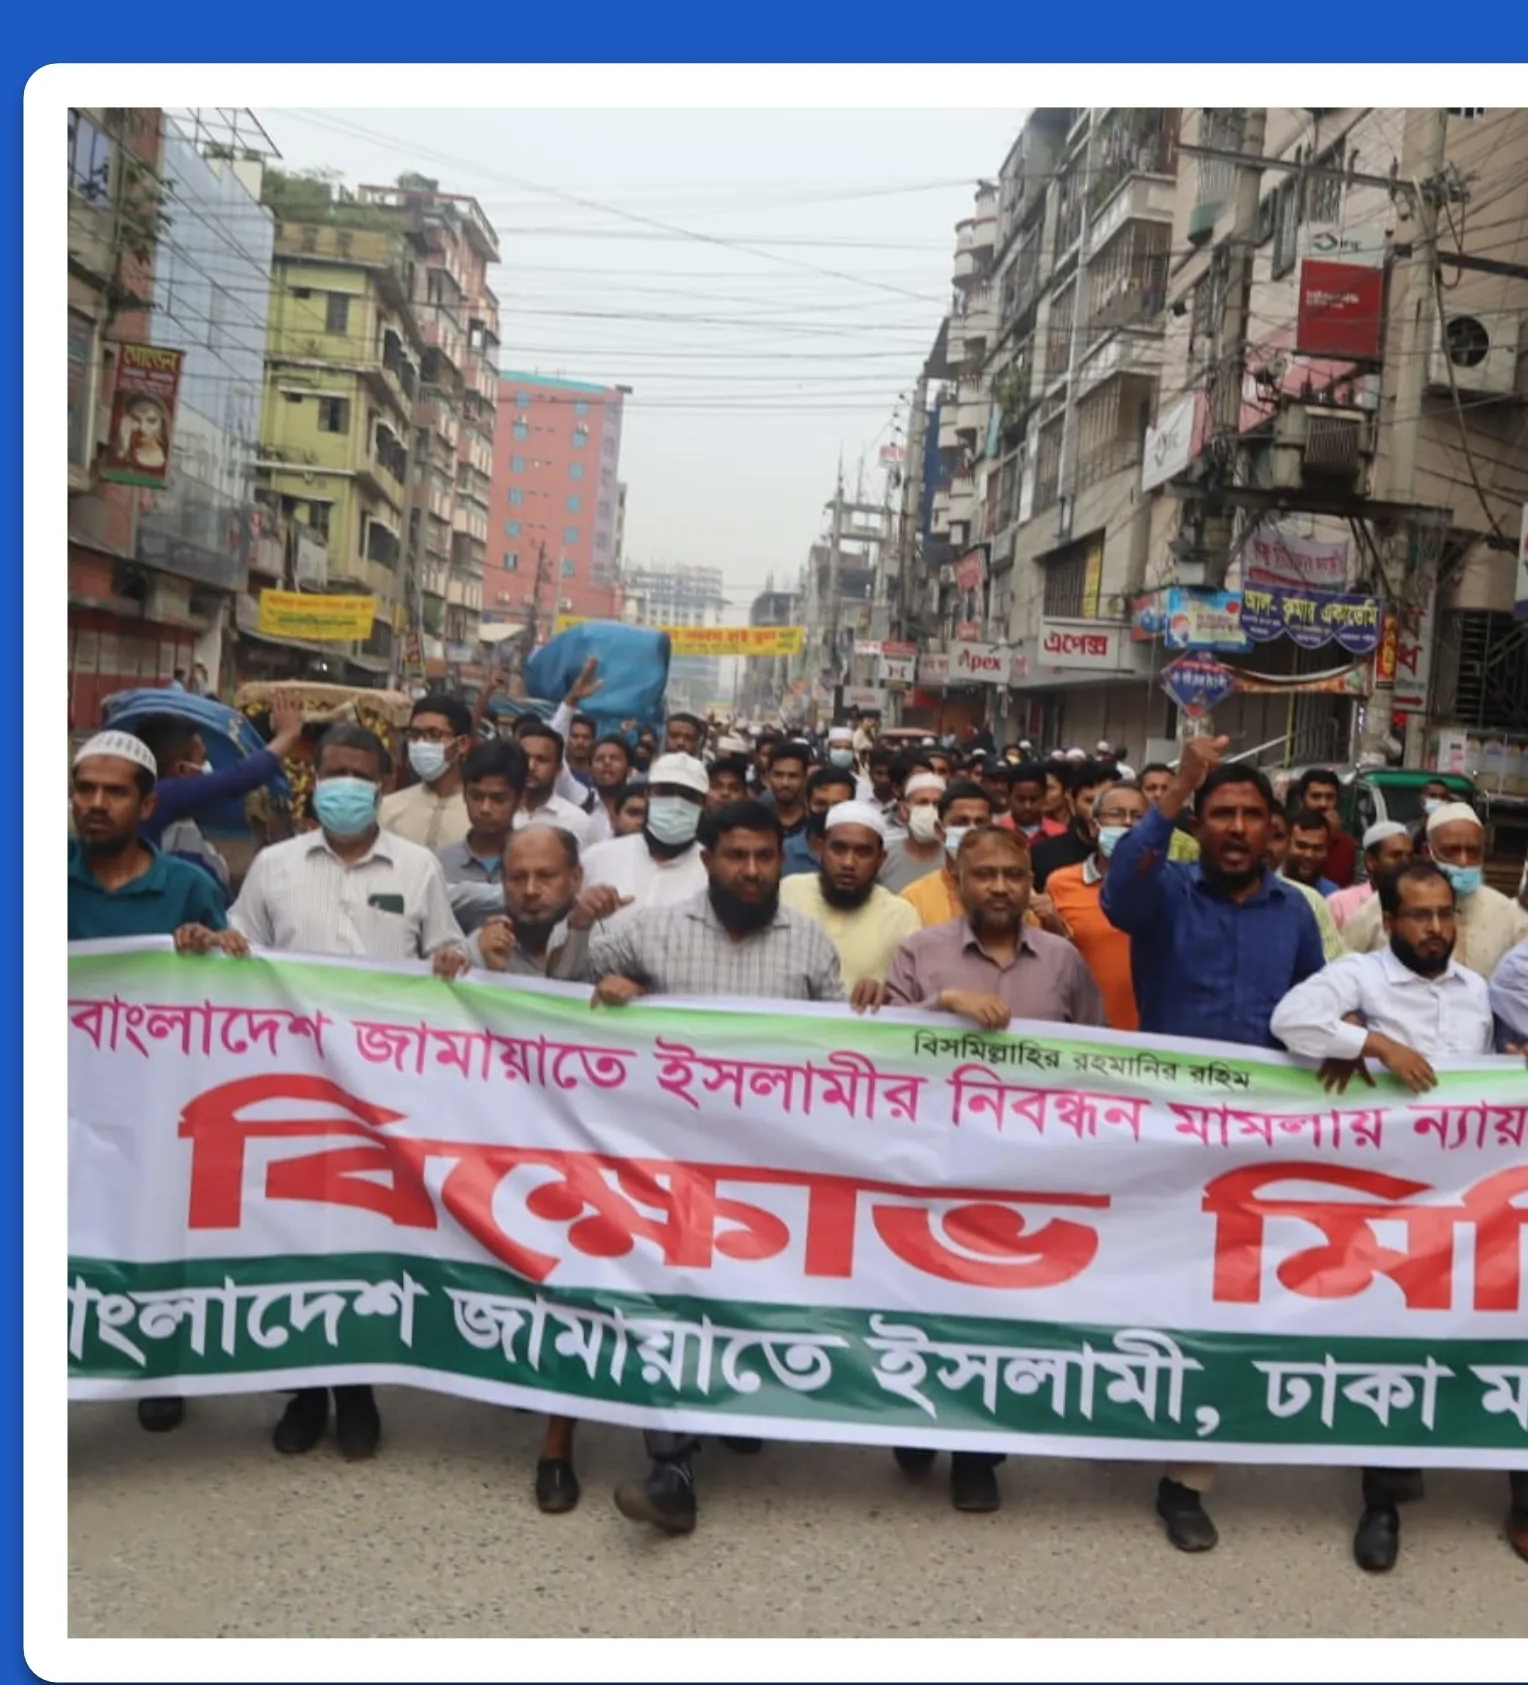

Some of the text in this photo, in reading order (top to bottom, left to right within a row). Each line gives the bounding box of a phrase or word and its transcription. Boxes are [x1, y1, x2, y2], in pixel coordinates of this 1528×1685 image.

[957, 648, 1003, 673] Apex
[1043, 631, 1109, 657] এপেক্স
[67, 993, 331, 1061] বাংলাদেশ
[354, 1018, 636, 1092] জামায়াতে
[654, 1035, 930, 1122] ইসলামীর
[945, 1062, 1157, 1143] নিবন্ধন
[1165, 1099, 1391, 1151] মামলায়
[913, 1029, 1252, 1090] বিসমিল্লাহির রহমানির রহিম
[177, 1072, 1111, 1291] বিক্ষোভ
[67, 1269, 429, 1368] াংলাদেশ
[443, 1285, 851, 1397] জামায়াতে
[864, 1313, 1222, 1438] ইসলামী,
[1251, 1353, 1457, 1432] ঢাকা
